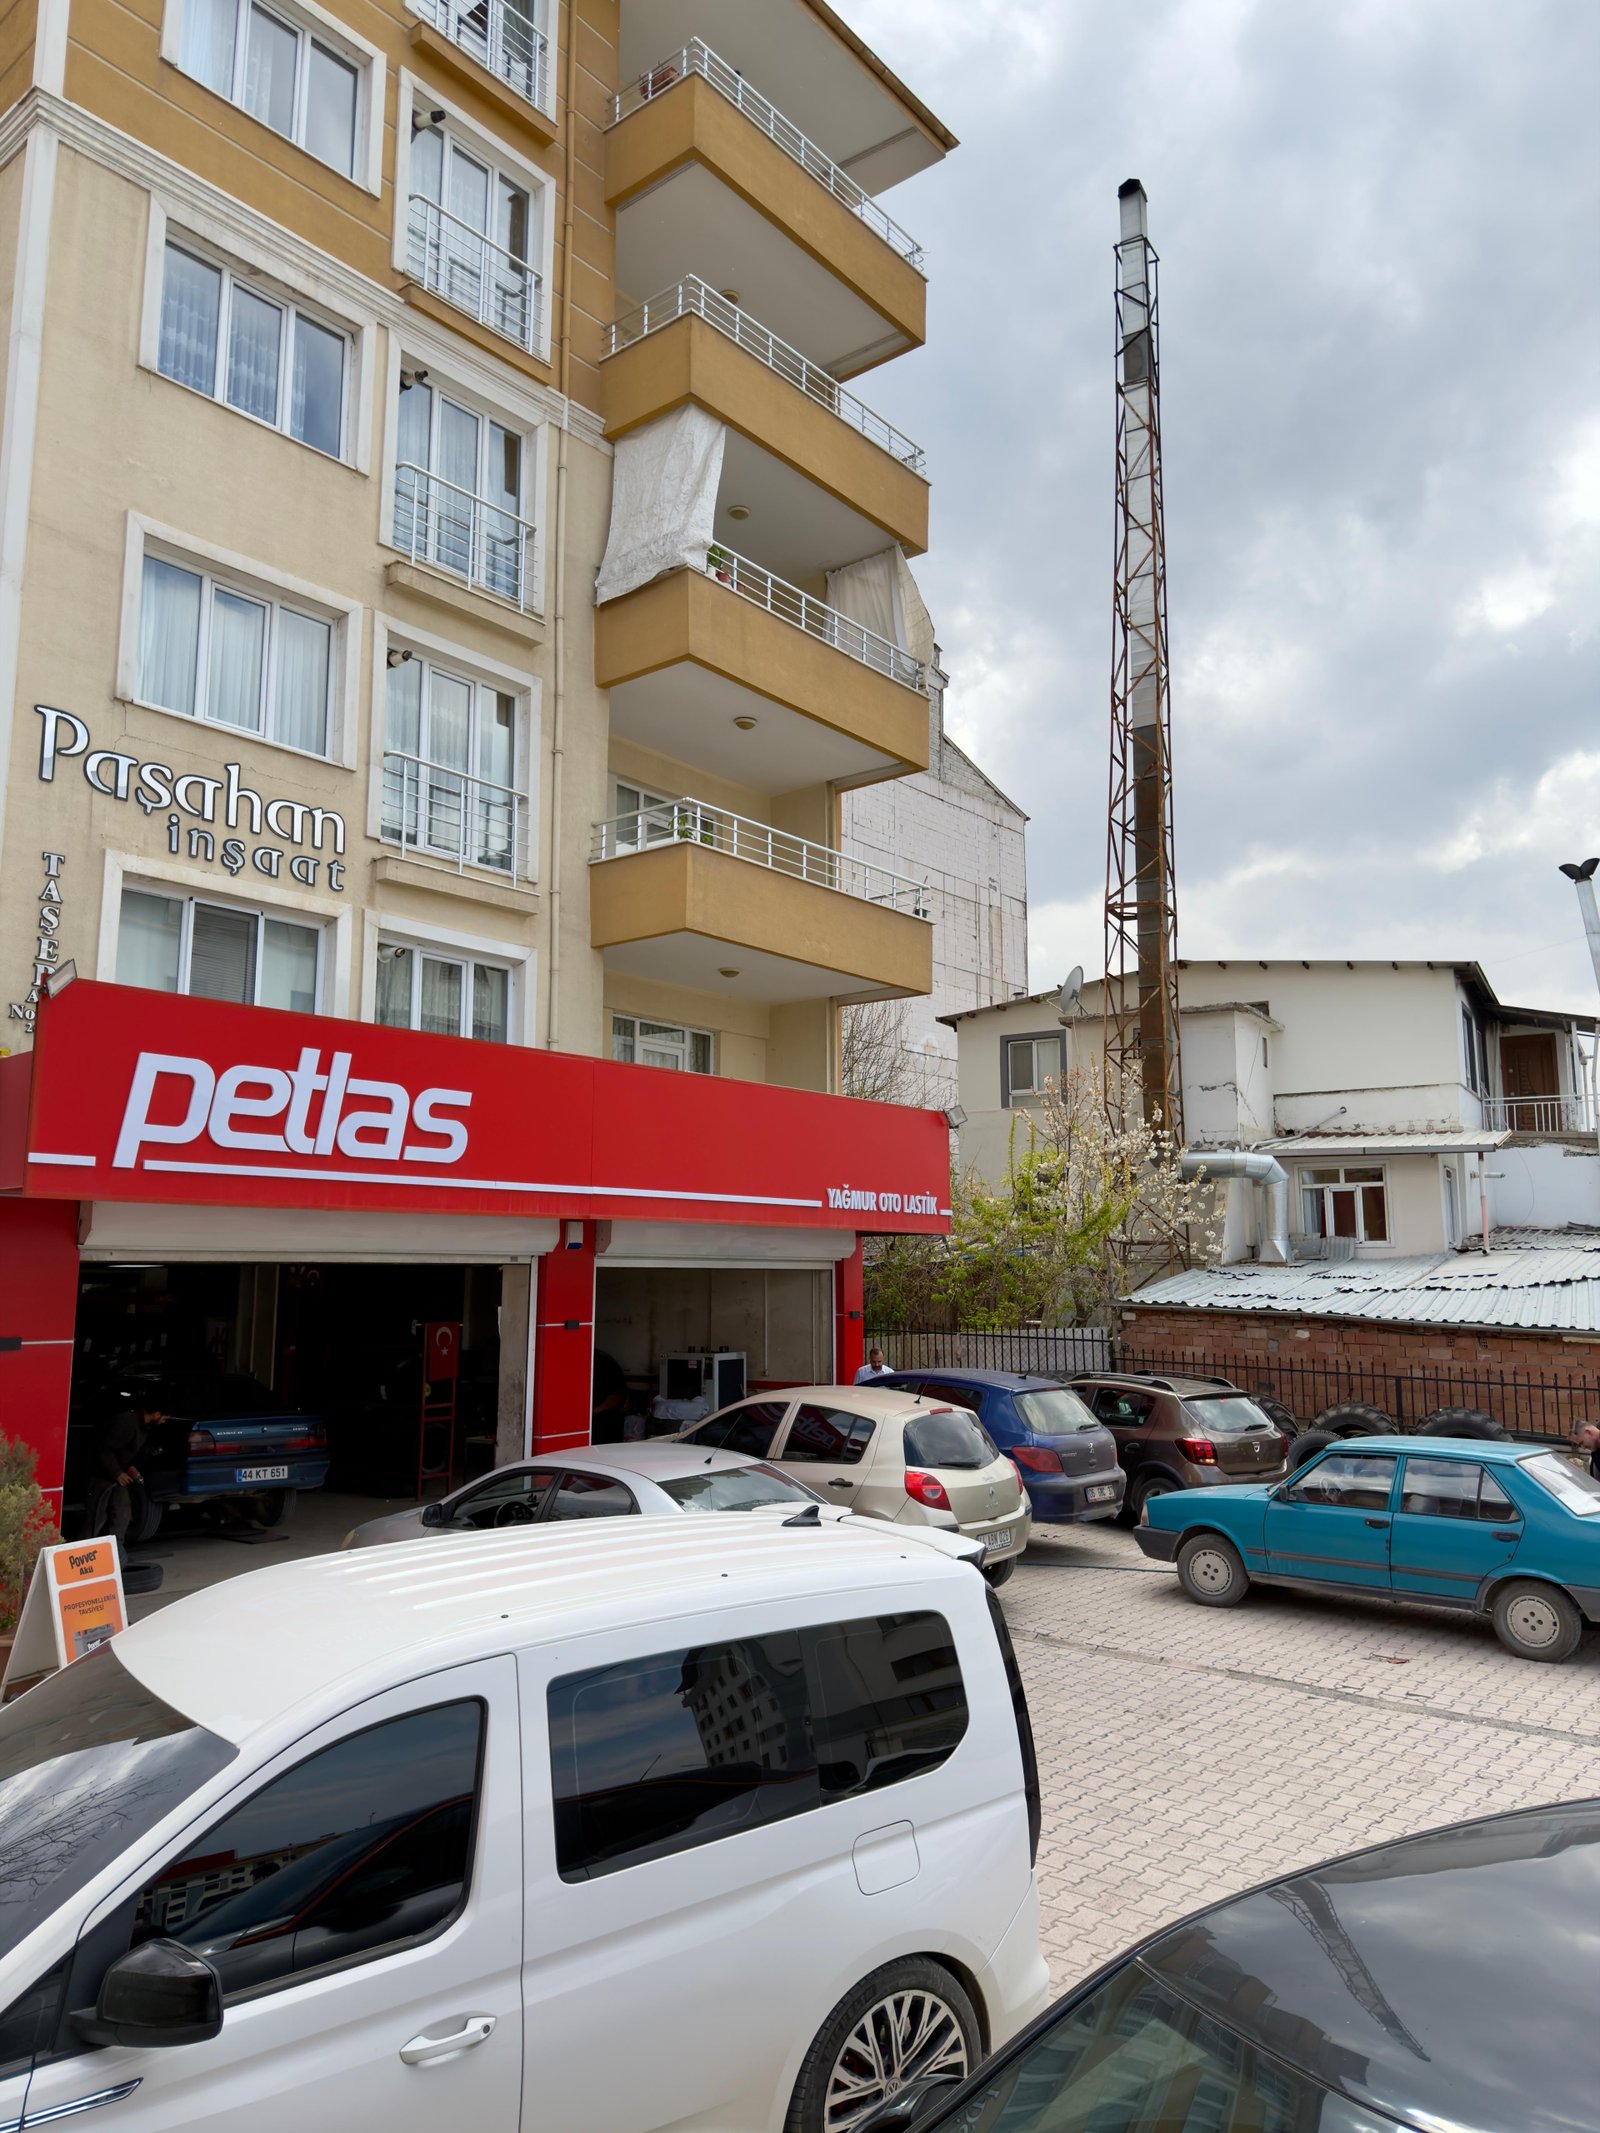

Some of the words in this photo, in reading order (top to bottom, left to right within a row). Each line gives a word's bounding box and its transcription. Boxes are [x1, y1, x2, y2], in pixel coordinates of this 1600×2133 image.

[34, 705, 345, 854] Paşahan
[167, 814, 346, 891] inşaat
[112, 1047, 472, 1168] petlas
[827, 1184, 877, 1212] YAĞMUR
[879, 1192, 902, 1213] OTO
[904, 1191, 937, 1215] LASTİK
[242, 1470, 253, 1480] 44
[255, 1469, 268, 1479] KT
[270, 1467, 285, 1478] 651
[63, 1594, 116, 1612] PROFESYONELLERİN
